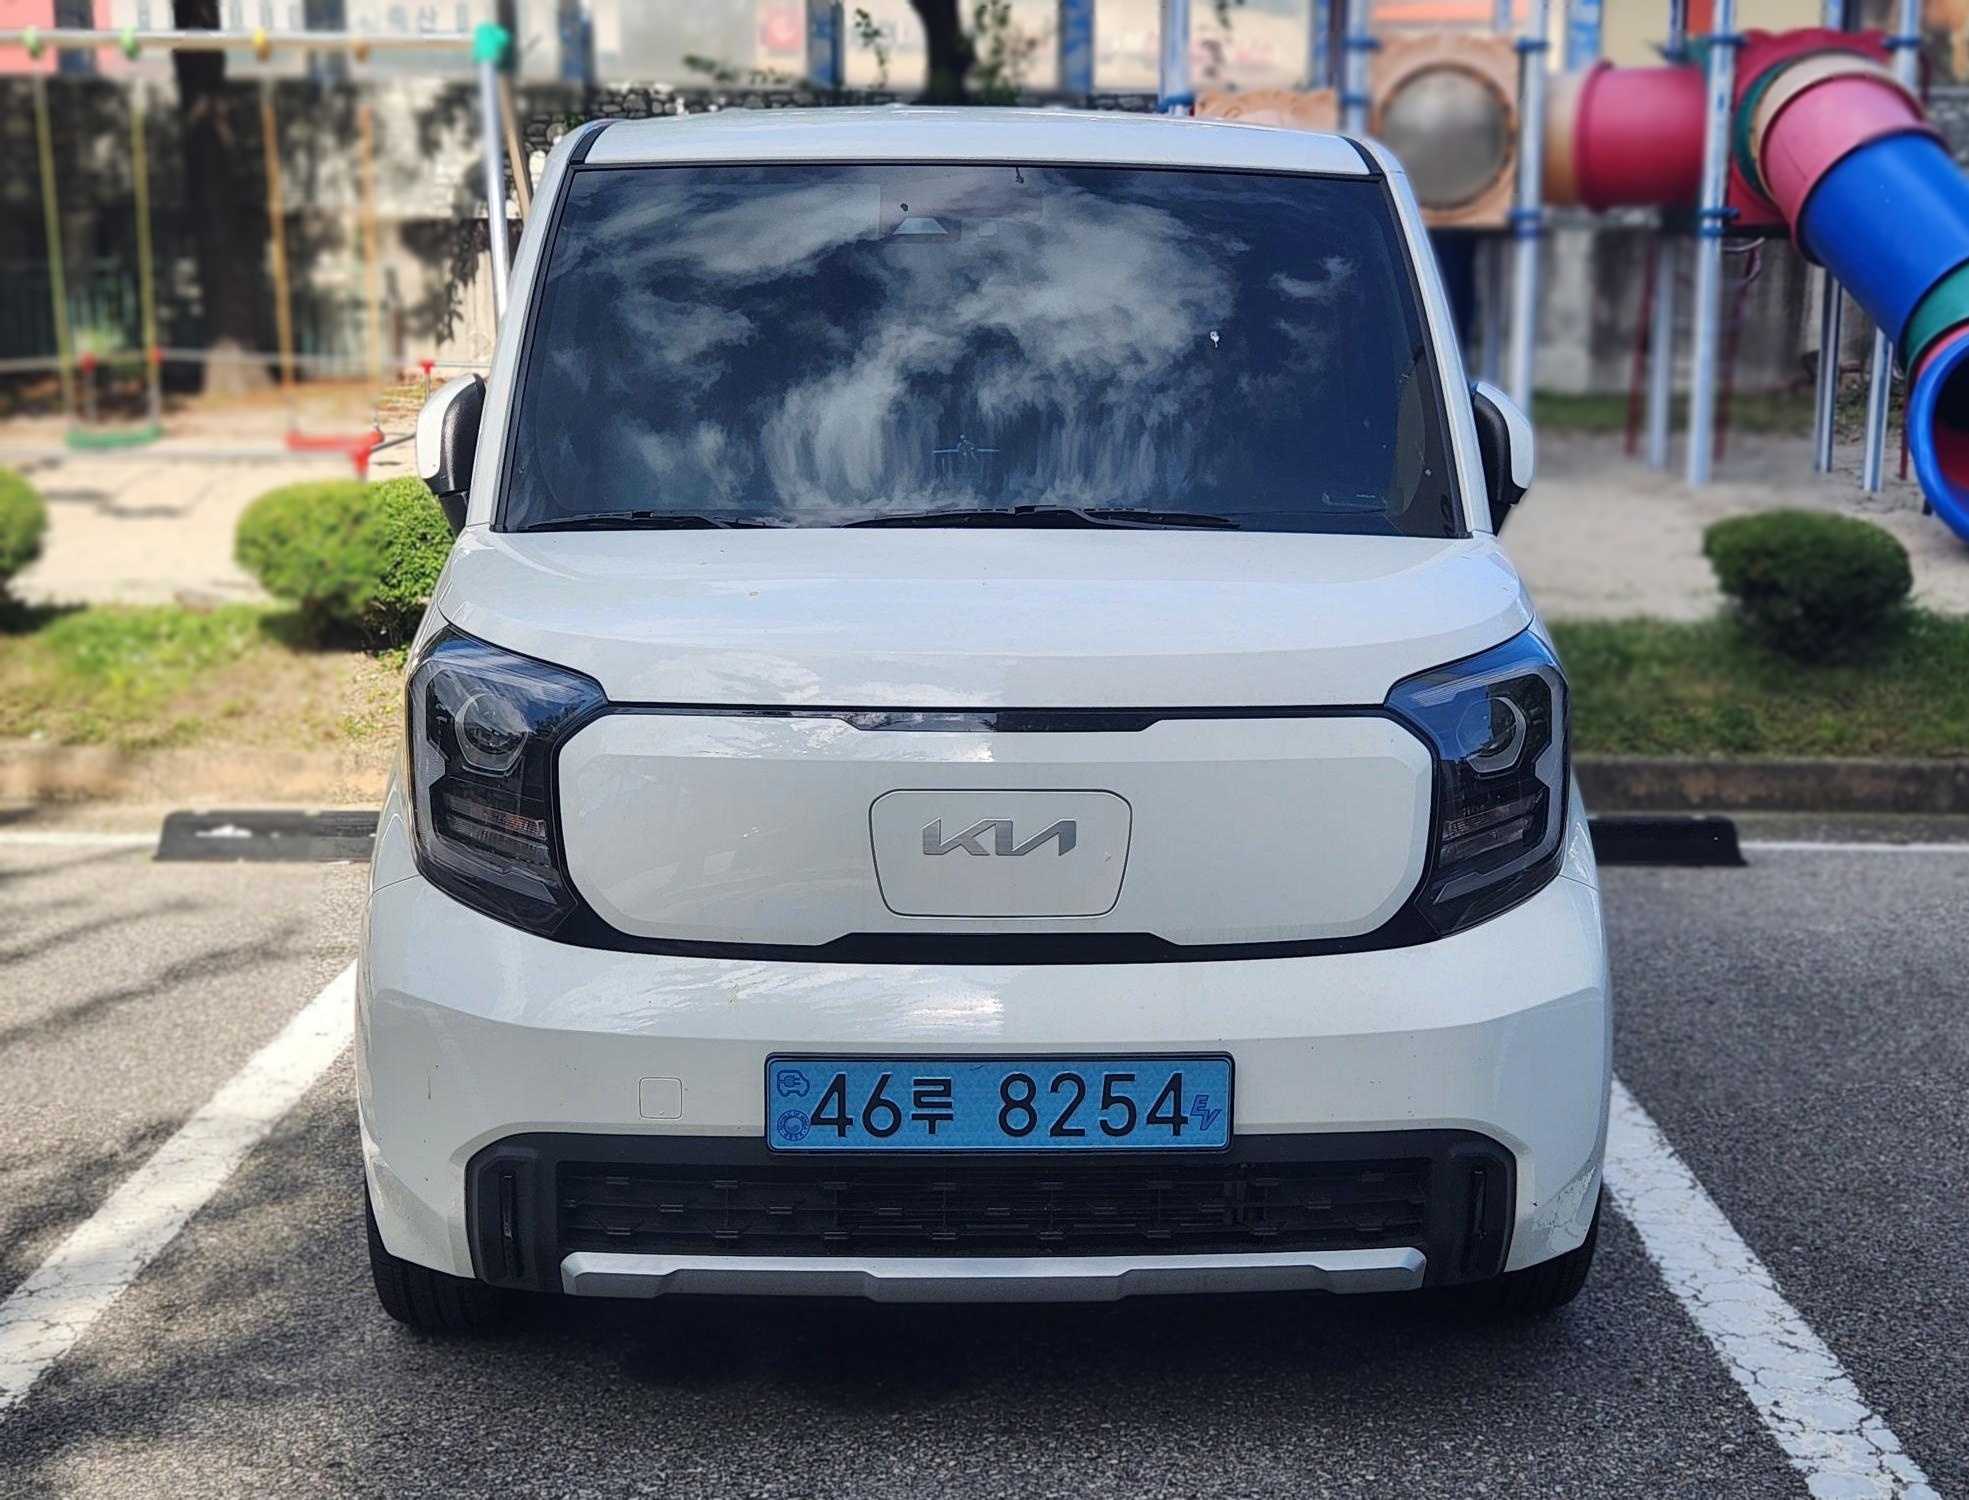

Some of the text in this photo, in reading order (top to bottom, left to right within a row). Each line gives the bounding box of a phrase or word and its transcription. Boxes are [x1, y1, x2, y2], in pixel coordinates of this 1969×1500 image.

[922, 818, 1077, 857] KIA
[809, 1072, 954, 1138] 46루
[998, 1072, 1189, 1138] 8254
[1189, 1094, 1223, 1131] EV
